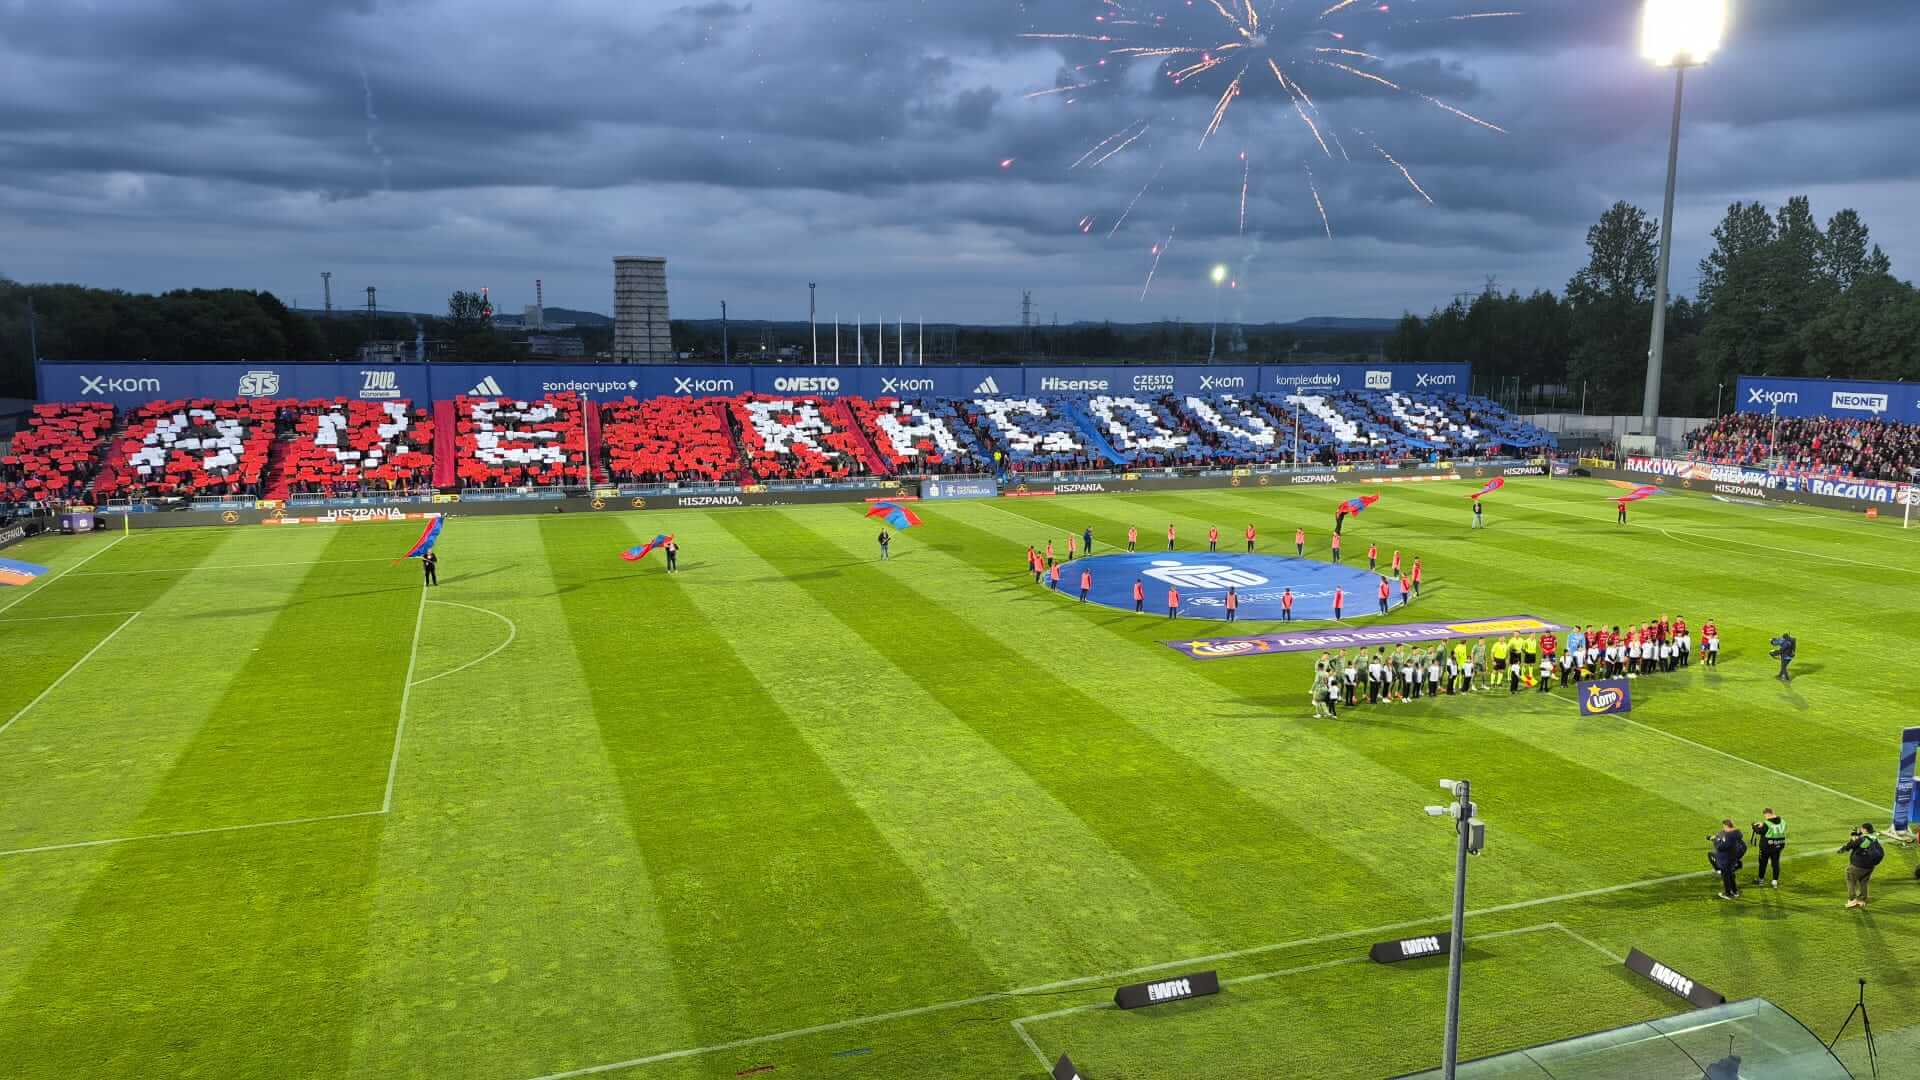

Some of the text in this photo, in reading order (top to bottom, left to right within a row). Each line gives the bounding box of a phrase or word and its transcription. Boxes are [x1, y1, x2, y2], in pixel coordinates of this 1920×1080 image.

[239, 371, 280, 397] STS
[543, 380, 626, 392] zondacrypto
[774, 377, 840, 391] ONESTO
[1041, 377, 1109, 391] Hisense
[1836, 396, 1884, 407] NEONET
